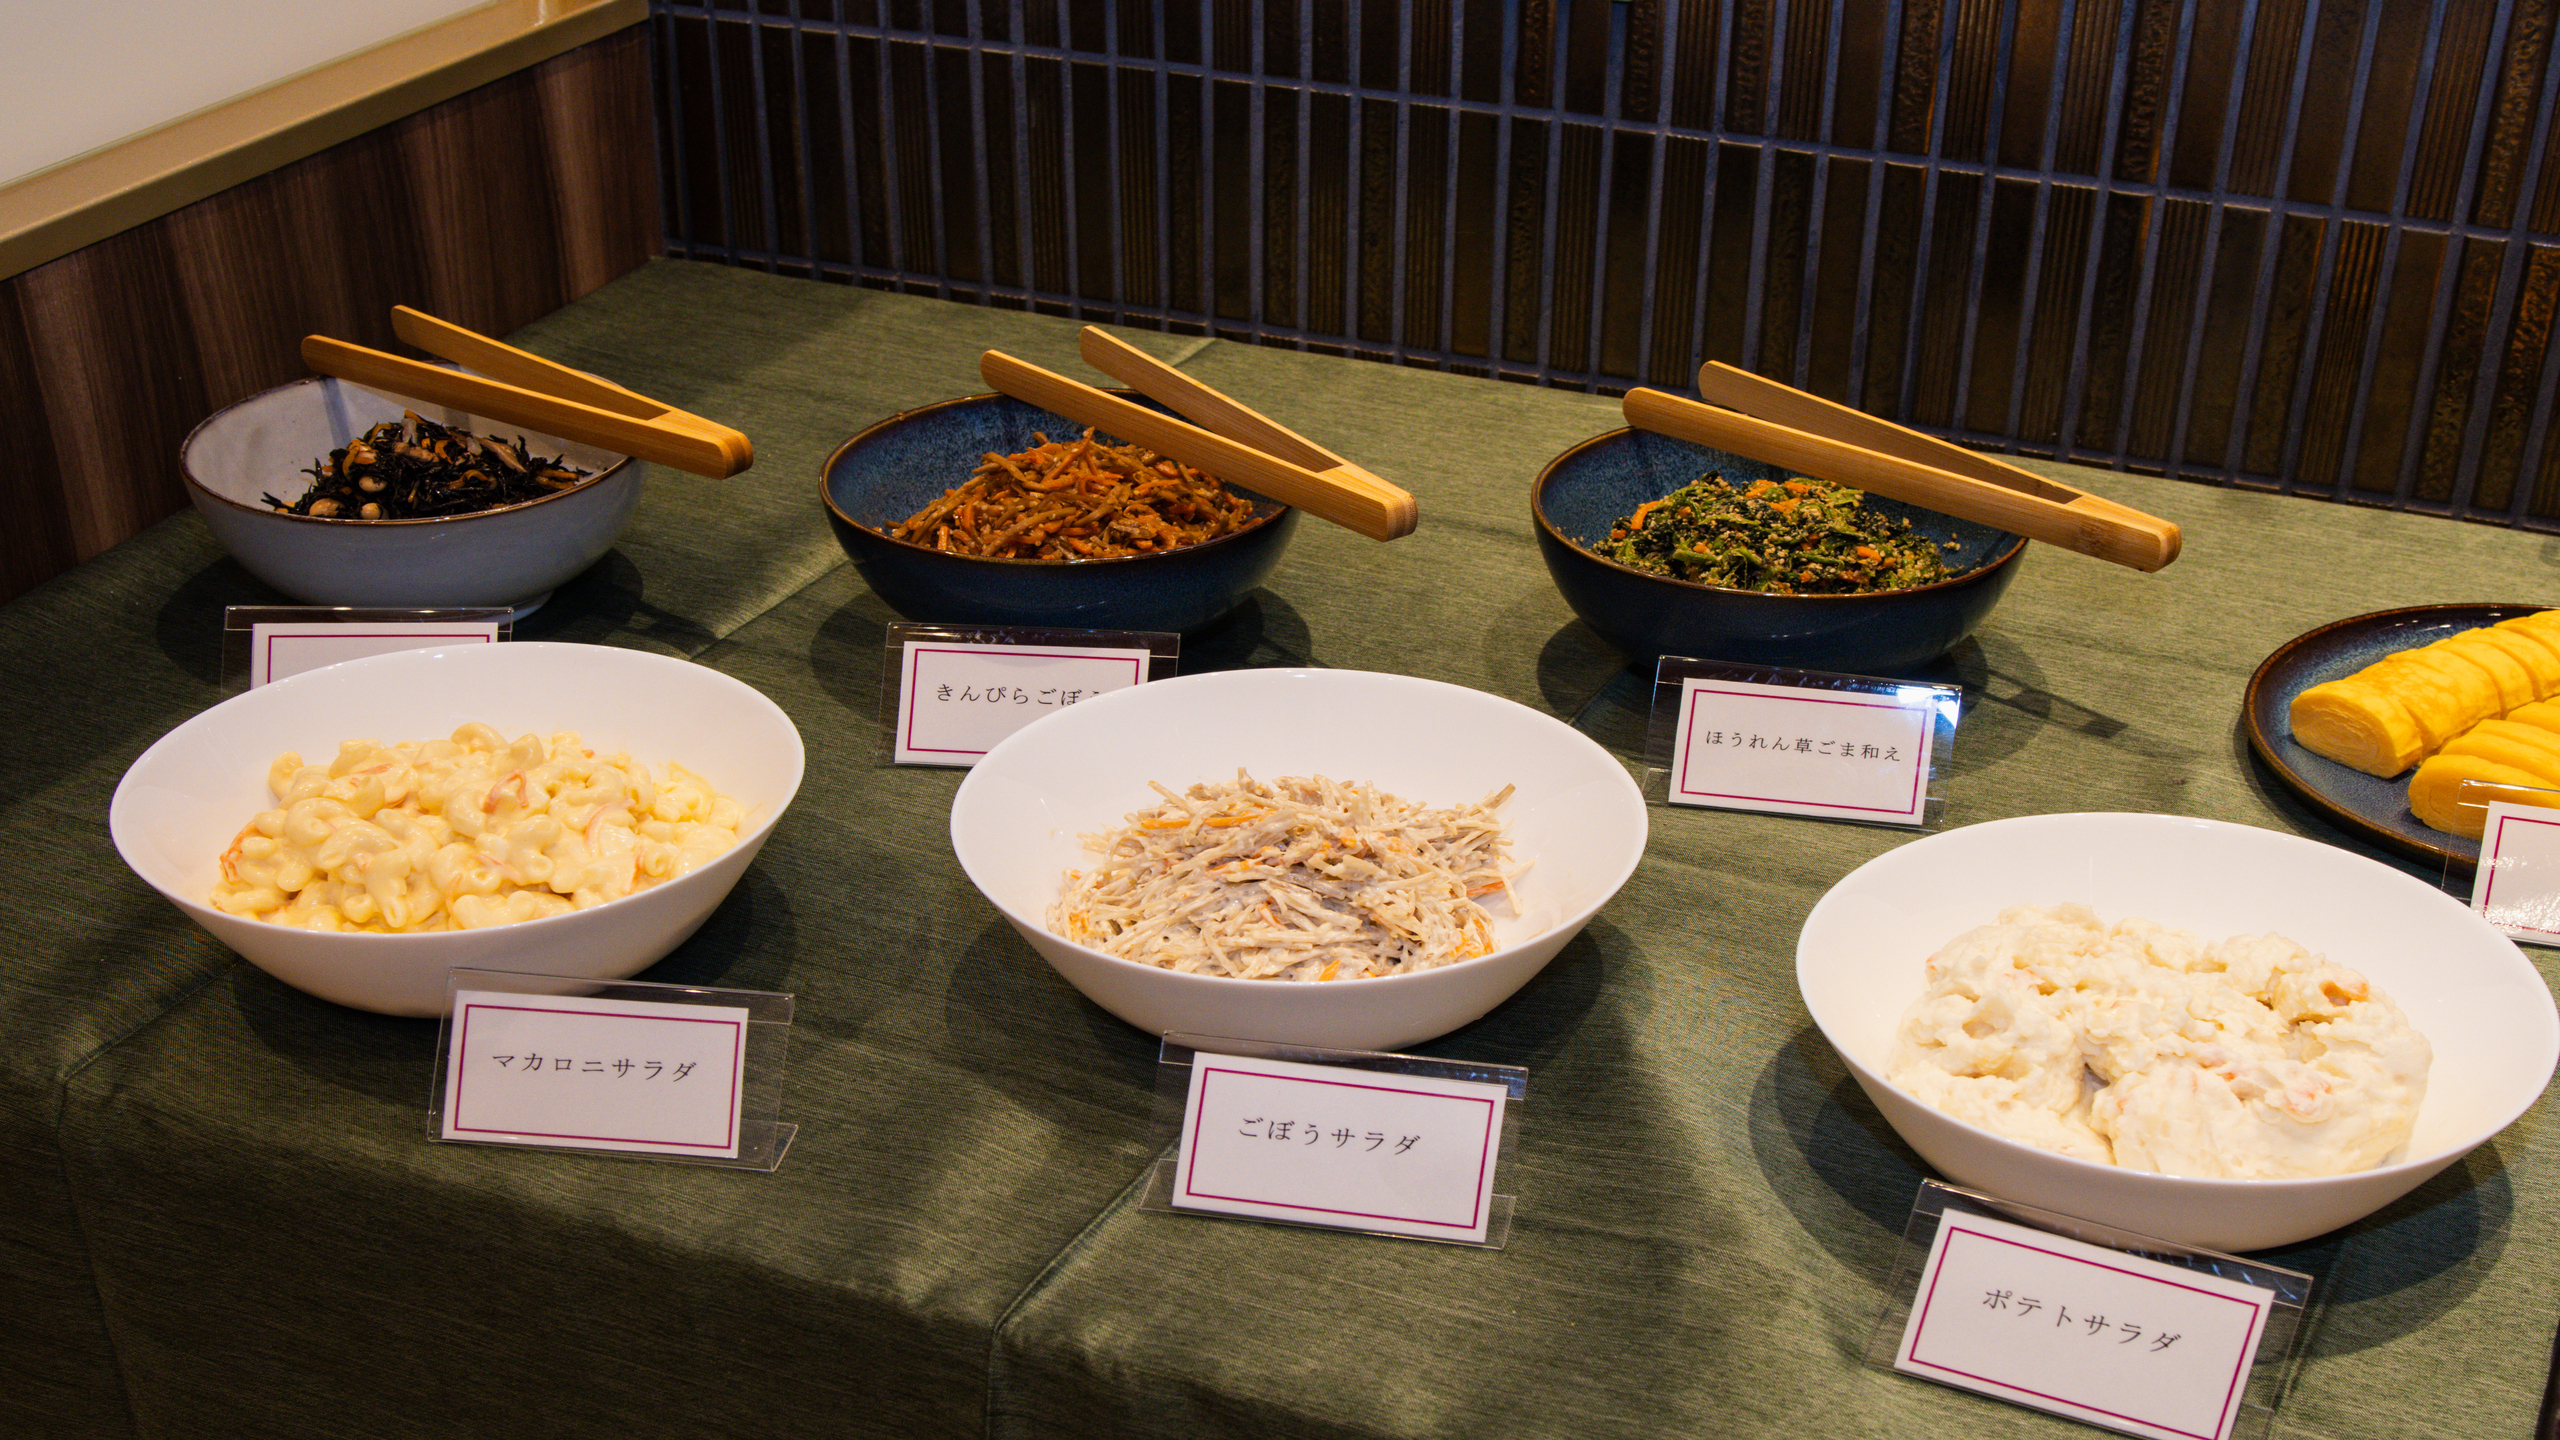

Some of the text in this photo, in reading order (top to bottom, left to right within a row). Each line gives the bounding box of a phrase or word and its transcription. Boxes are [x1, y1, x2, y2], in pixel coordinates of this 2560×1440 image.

[1706, 730, 1900, 762] ほうれん草ごま和え
[492, 1053, 696, 1082] マカロニサラダ
[1238, 1117, 1420, 1155] ごぼうサラダ
[1982, 1289, 2181, 1352] ポテトサラダ
